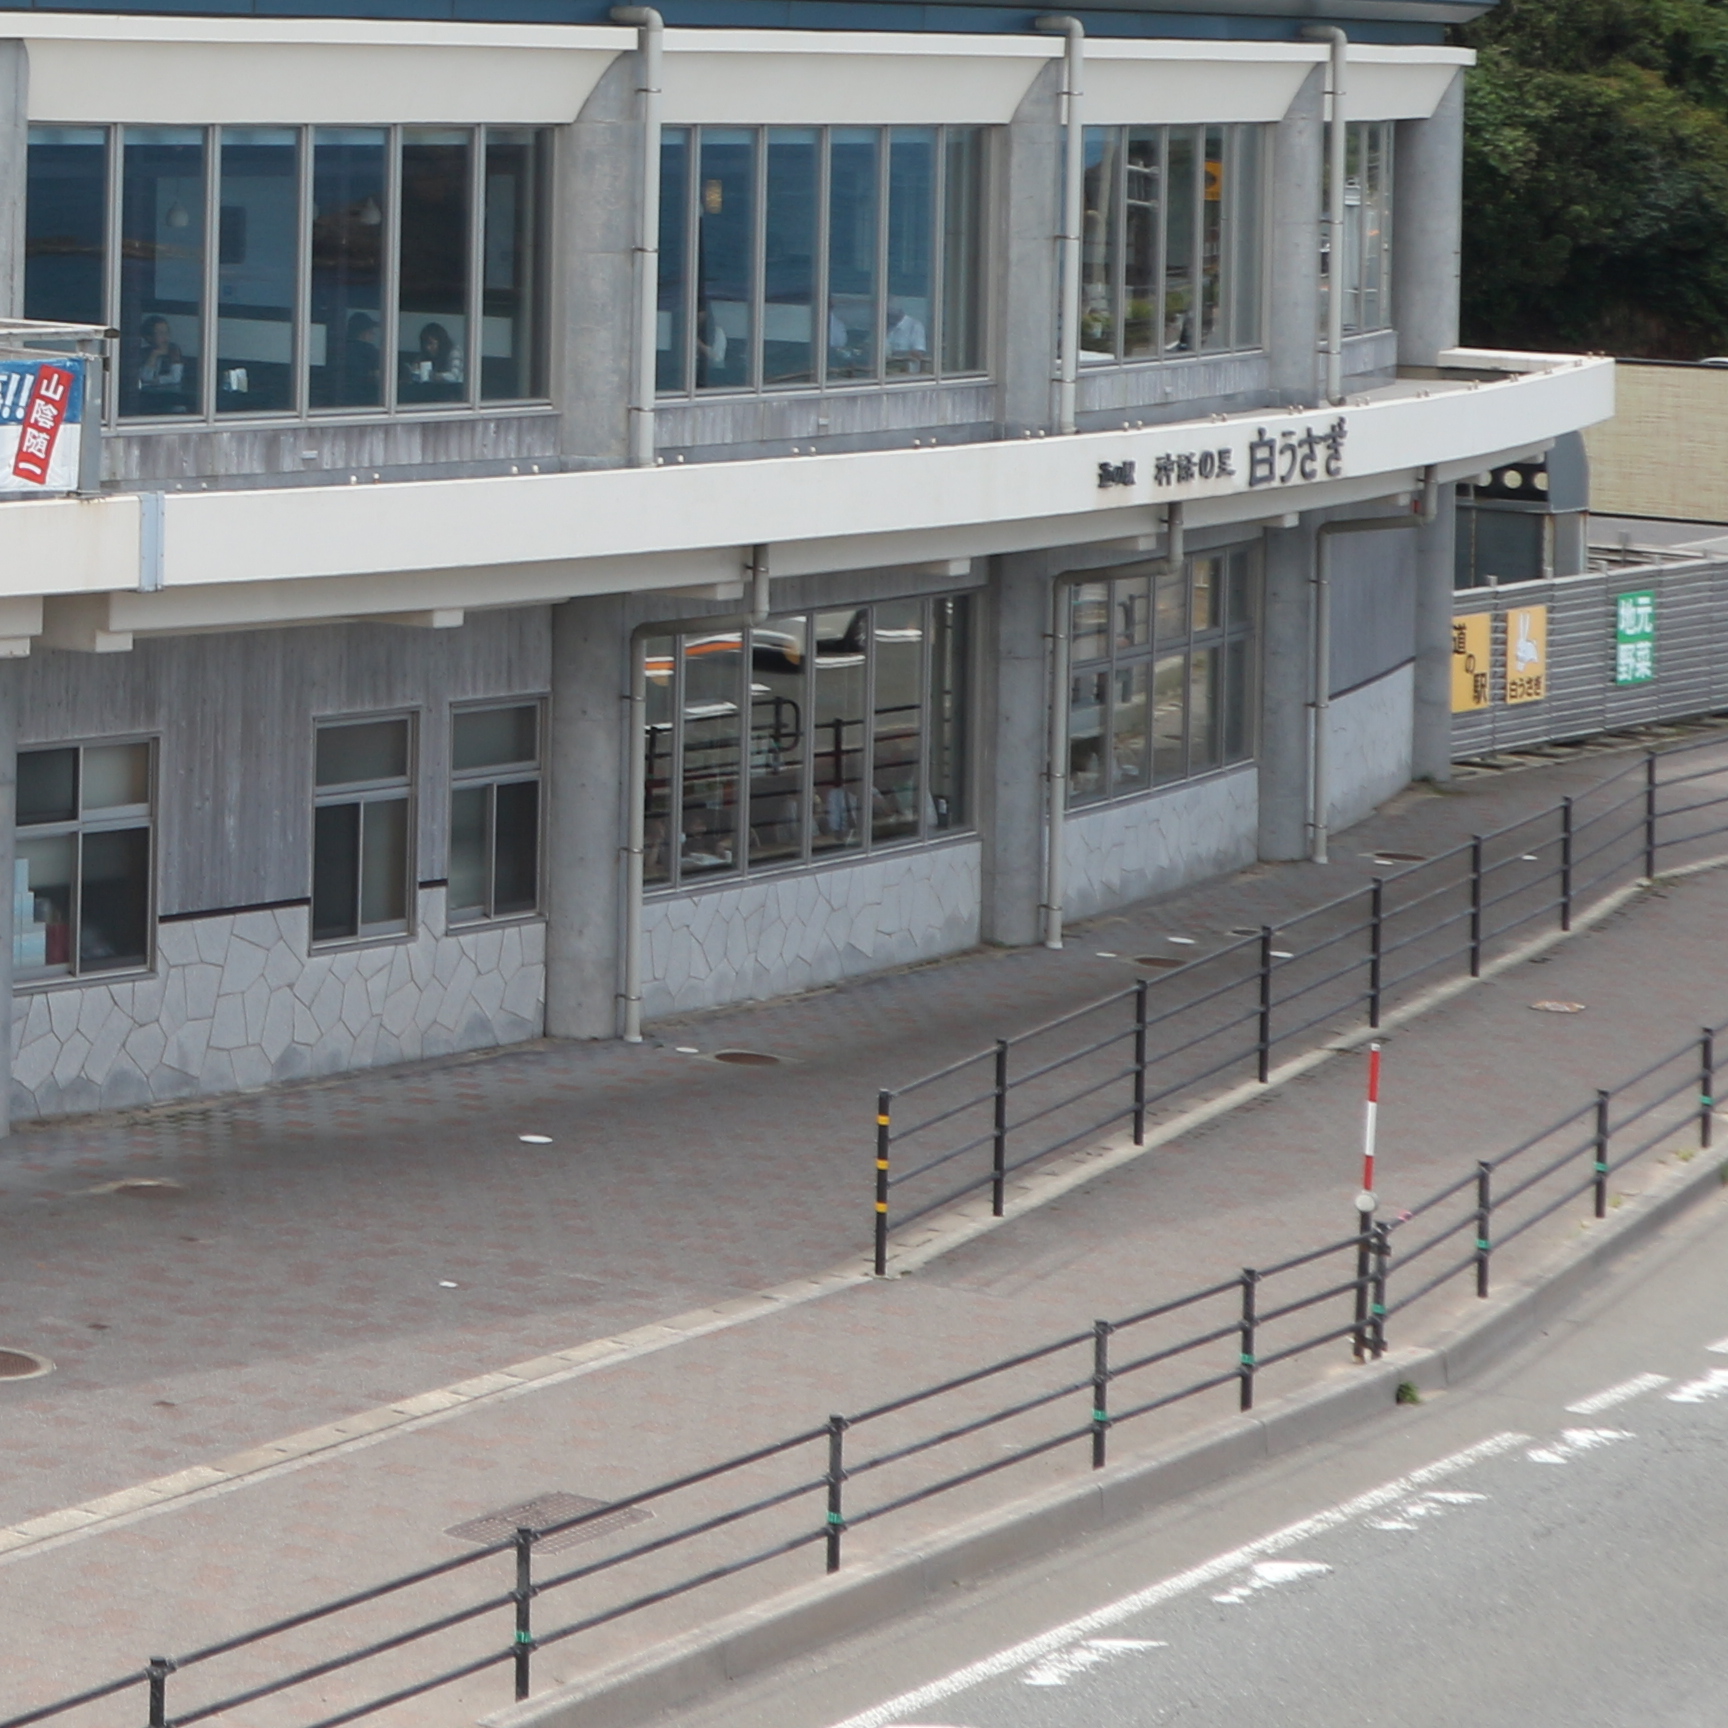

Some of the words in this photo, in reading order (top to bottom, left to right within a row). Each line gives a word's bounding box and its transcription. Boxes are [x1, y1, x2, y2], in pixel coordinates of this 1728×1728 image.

[18, 372, 65, 476] 山陰随一
[1248, 415, 1348, 488] 白うさぎ
[1618, 596, 1653, 635] 地元
[1453, 622, 1488, 705] 道の駅
[1509, 675, 1543, 700] 白うさぎ
[1616, 640, 1653, 682] 野菜
